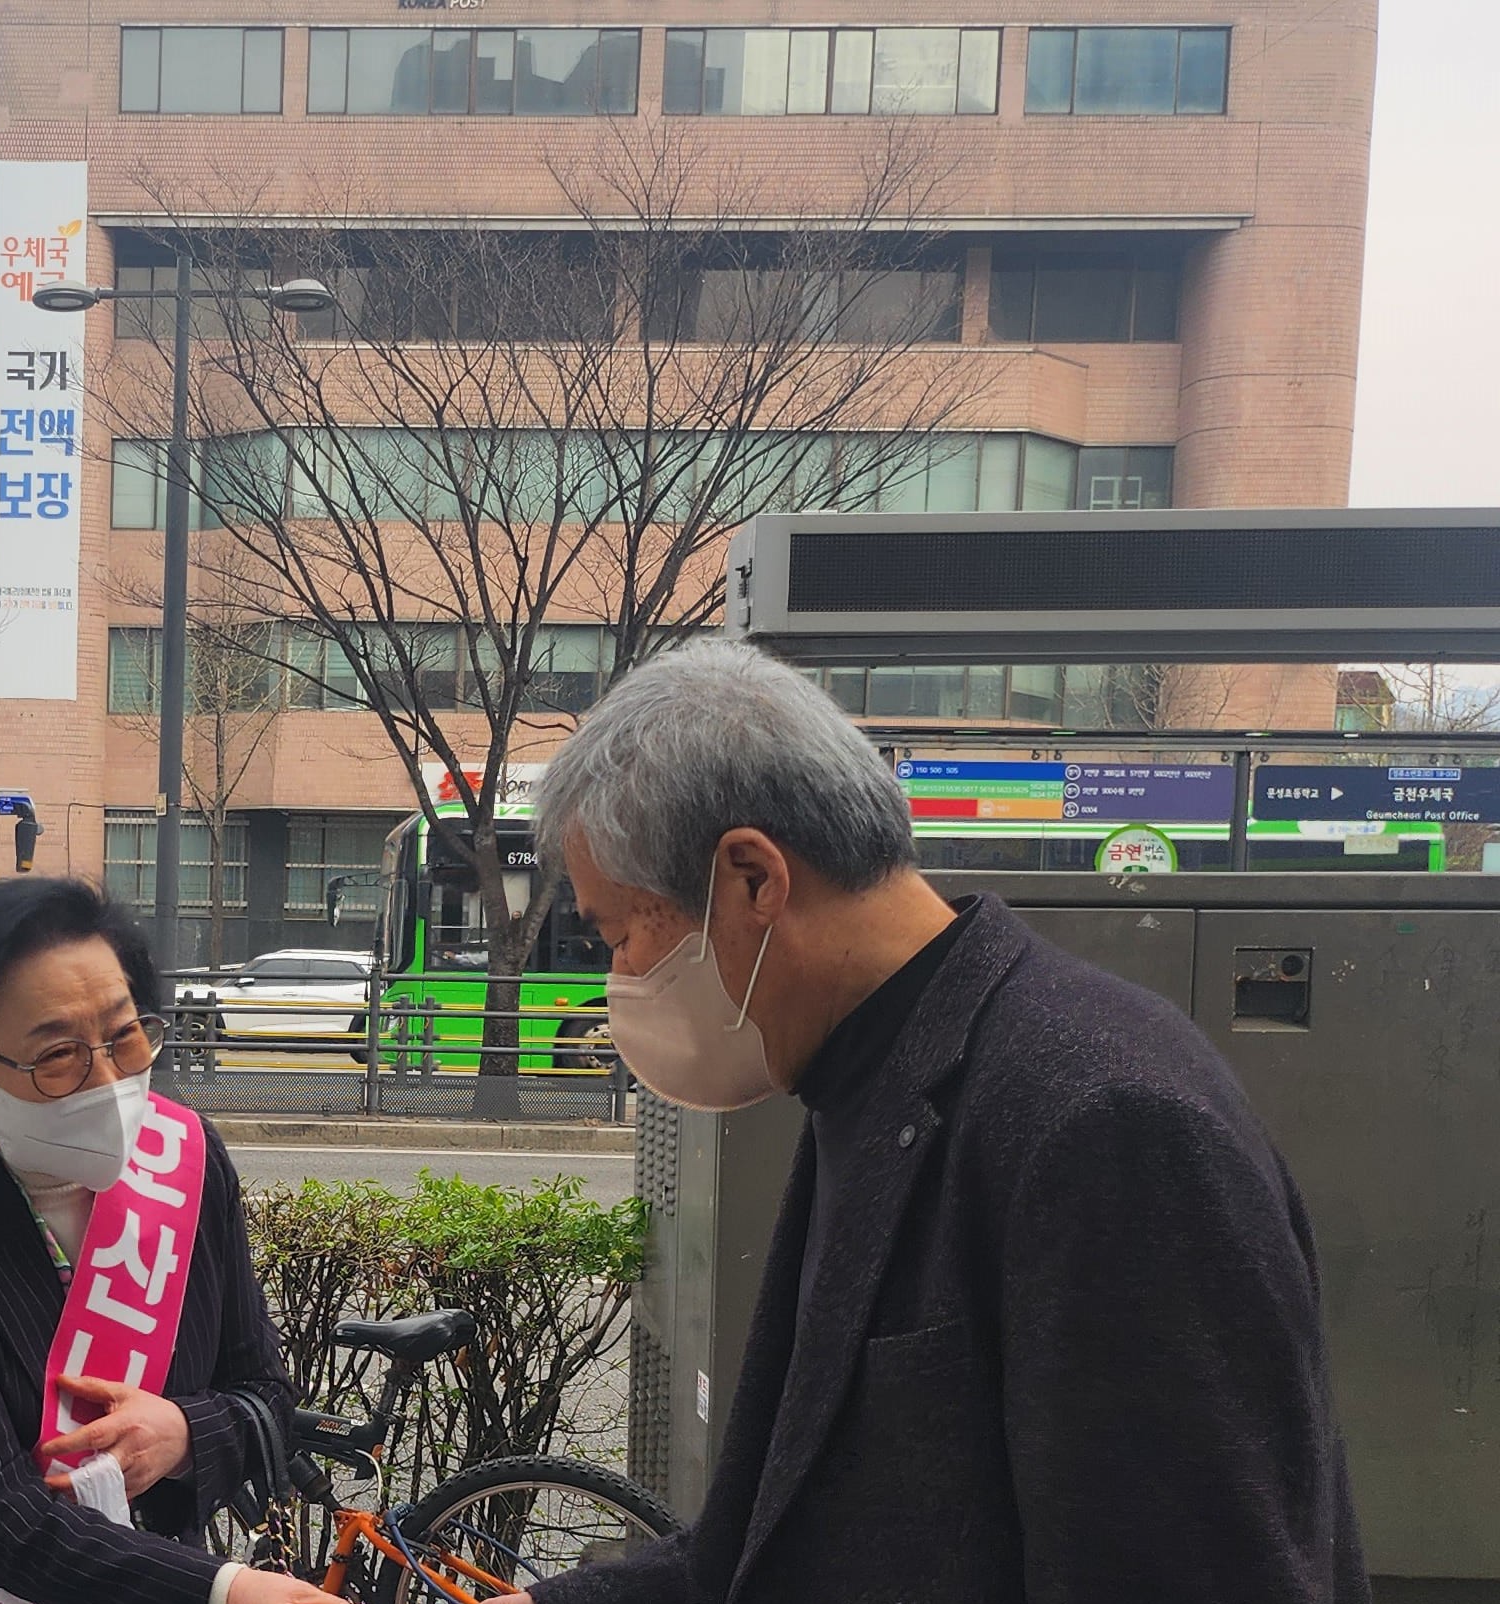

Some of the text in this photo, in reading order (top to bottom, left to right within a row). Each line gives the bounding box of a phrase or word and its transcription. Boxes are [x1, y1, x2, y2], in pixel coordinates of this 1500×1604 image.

[0, 236, 69, 268] 우체국
[6, 350, 70, 391] 국가
[0, 408, 75, 457] 전액
[1392, 787, 1455, 802] 금천우체국
[1365, 810, 1480, 821] Geumcheon Post Office
